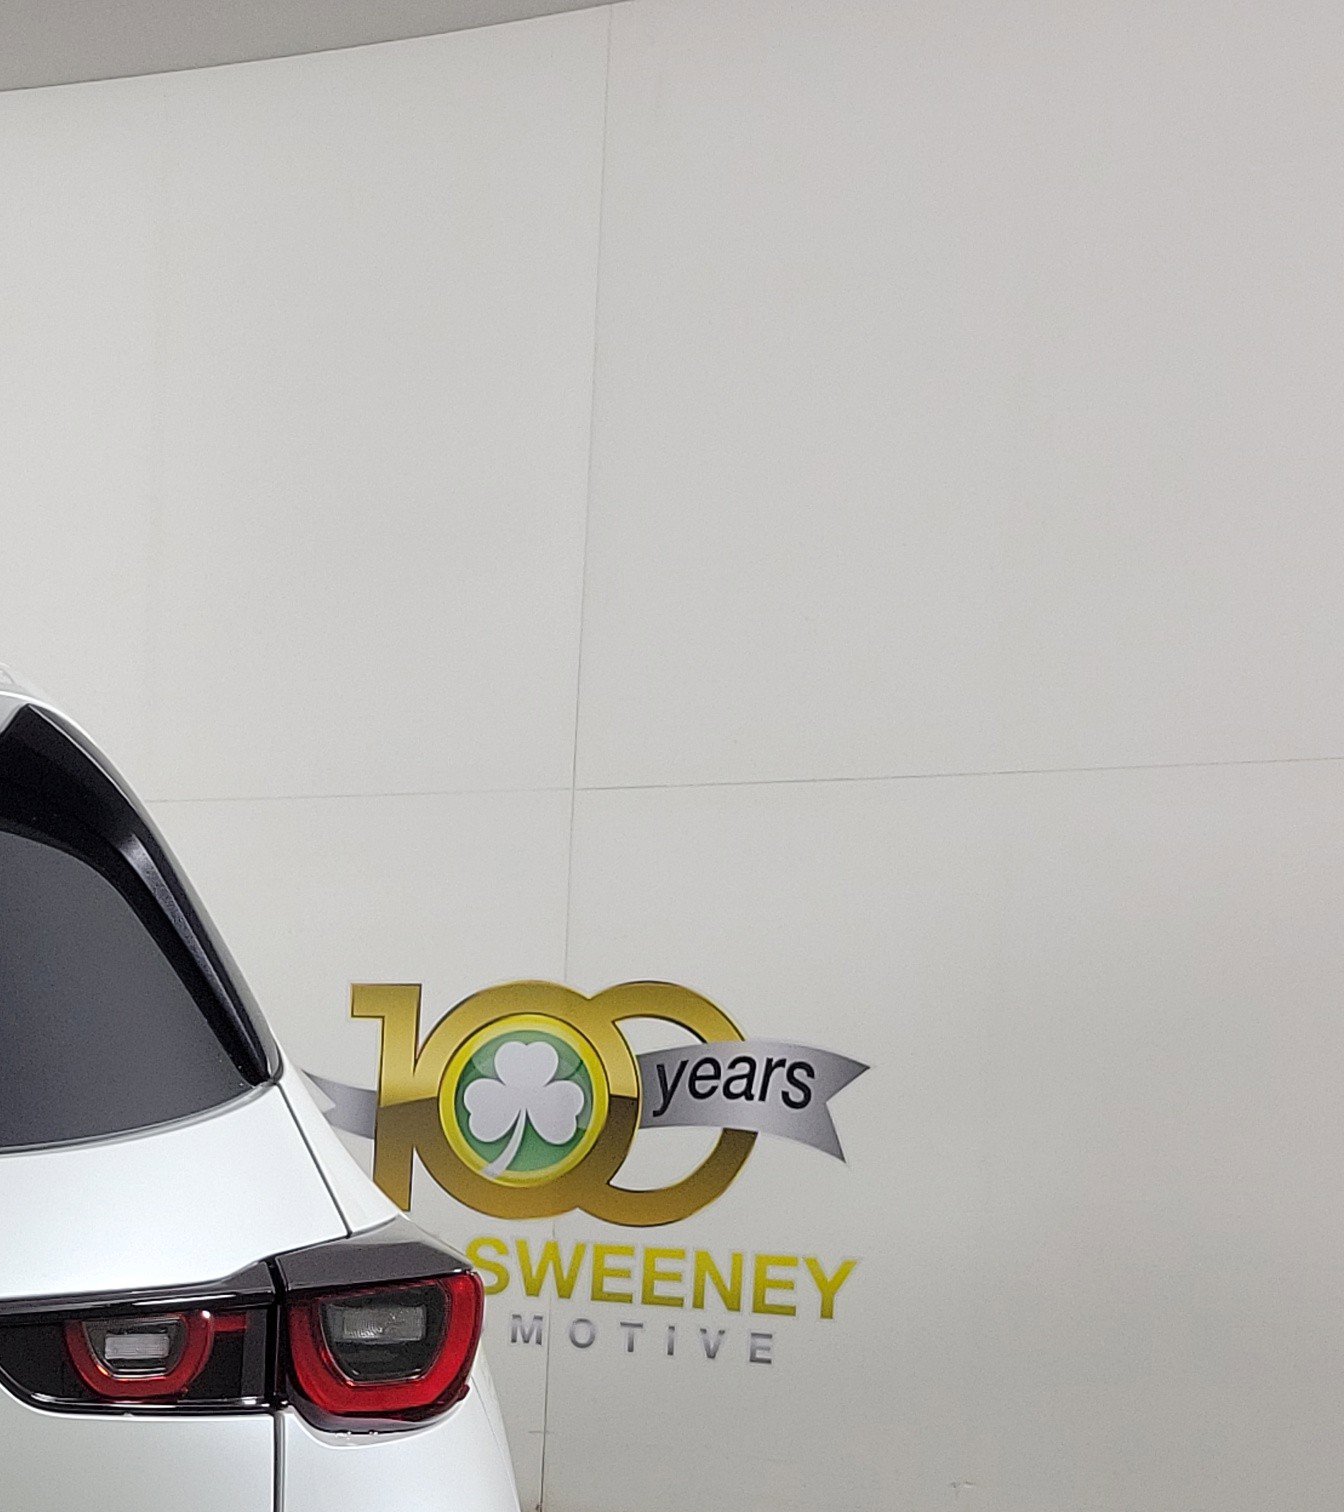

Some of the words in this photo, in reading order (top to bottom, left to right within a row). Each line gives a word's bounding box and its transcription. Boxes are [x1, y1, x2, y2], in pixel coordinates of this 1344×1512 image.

[652, 1054, 816, 1117] years
[466, 1237, 858, 1320] SWEENEY
[510, 1313, 774, 1365] MOTIVE
